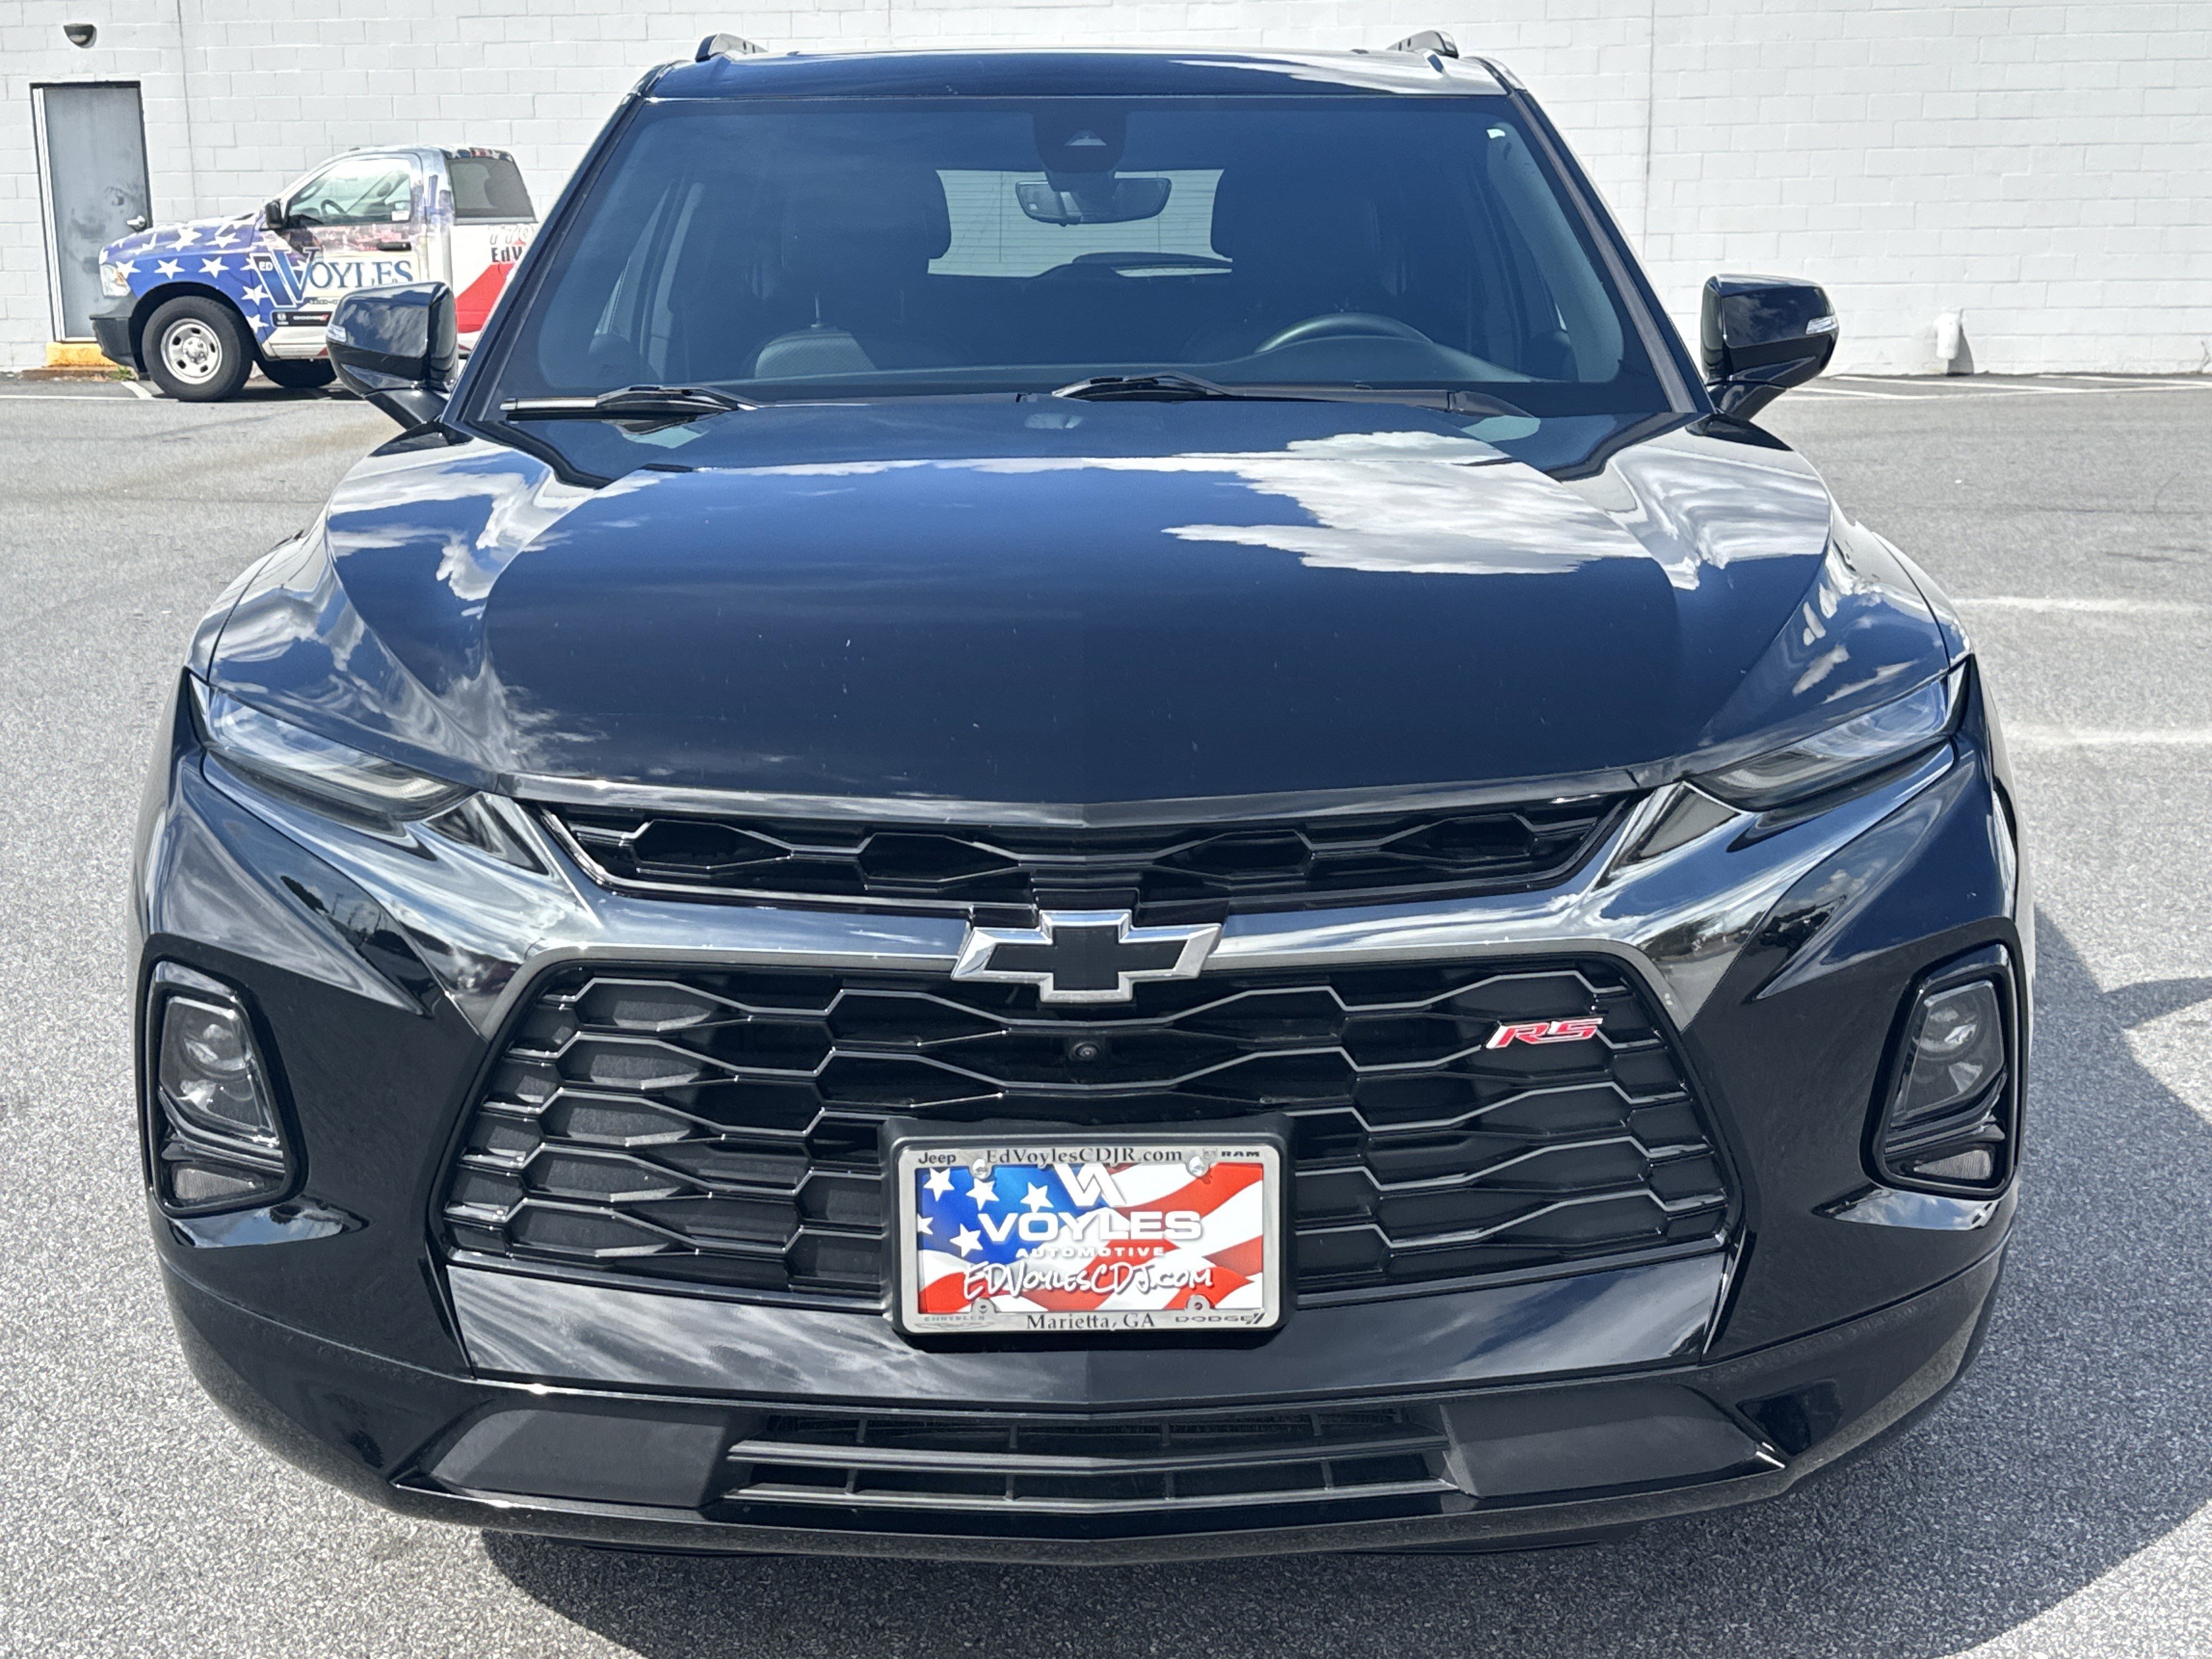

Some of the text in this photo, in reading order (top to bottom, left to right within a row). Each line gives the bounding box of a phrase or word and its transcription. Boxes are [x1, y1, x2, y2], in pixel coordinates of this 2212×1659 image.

[258, 261, 274, 271] ED
[267, 246, 414, 303] VOYLES
[1486, 1017, 1604, 1049] RS
[917, 1152, 956, 1165] Jeep
[986, 1147, 1182, 1167] EdVoylesCDJR.com
[977, 1210, 1201, 1242] VOYLES
[1015, 1246, 1165, 1258] AUTOMOTIVE
[1026, 1312, 1156, 1329] Marietta, GA
